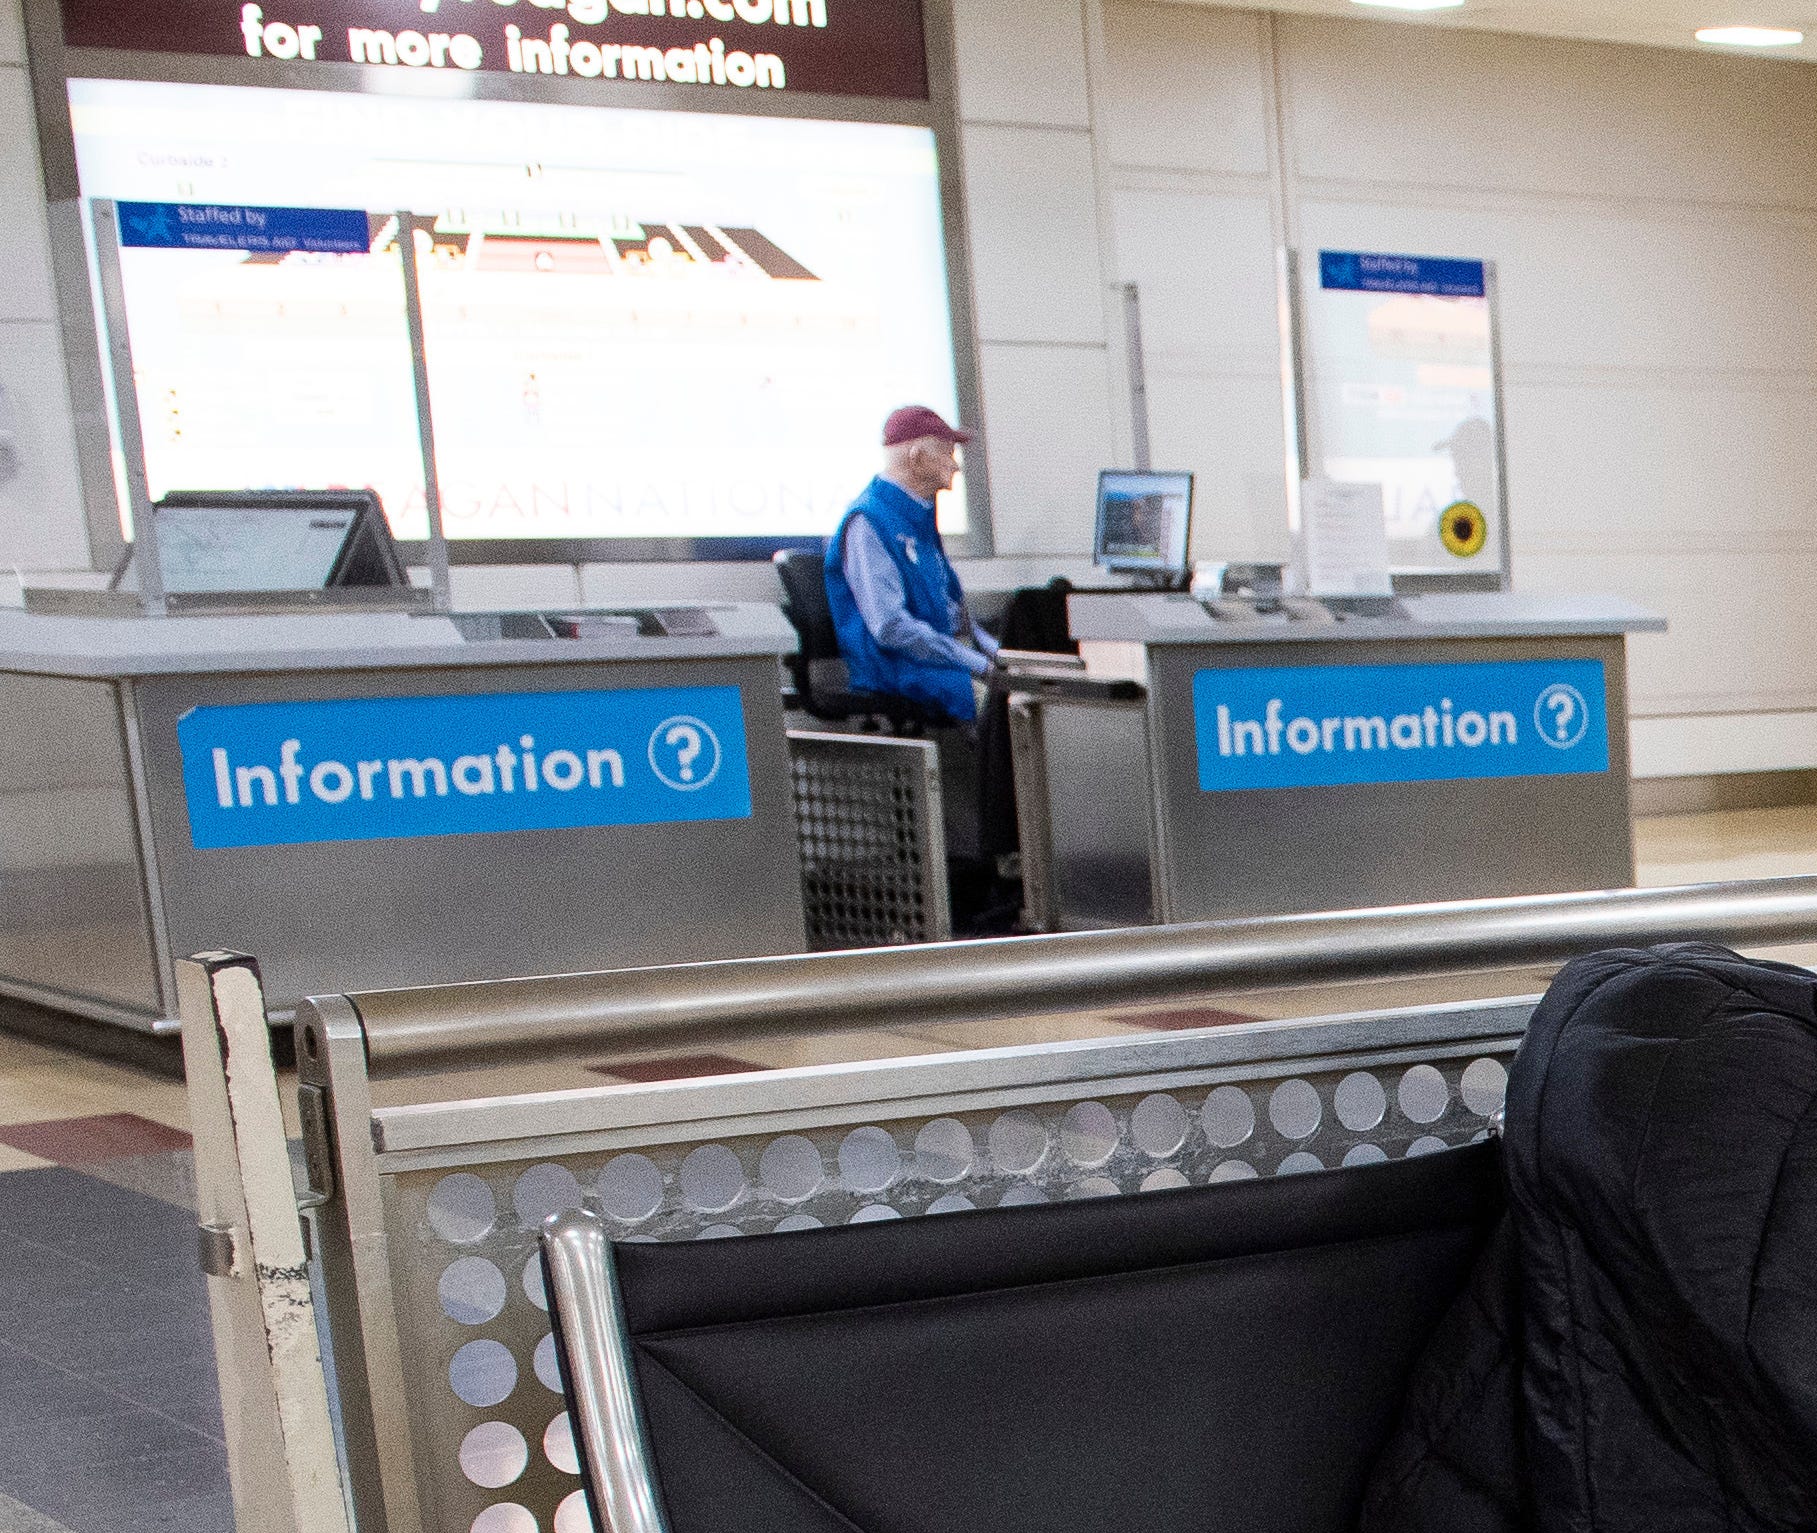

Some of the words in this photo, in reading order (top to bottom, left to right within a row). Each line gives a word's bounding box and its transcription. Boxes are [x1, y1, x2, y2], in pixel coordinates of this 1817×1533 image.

[240, 2, 322, 60] for
[347, 27, 483, 68] more
[504, 23, 786, 89] information
[178, 205, 241, 225] Staffed
[246, 207, 266, 228] by
[1216, 696, 1518, 758] Information
[211, 734, 626, 810] Information
